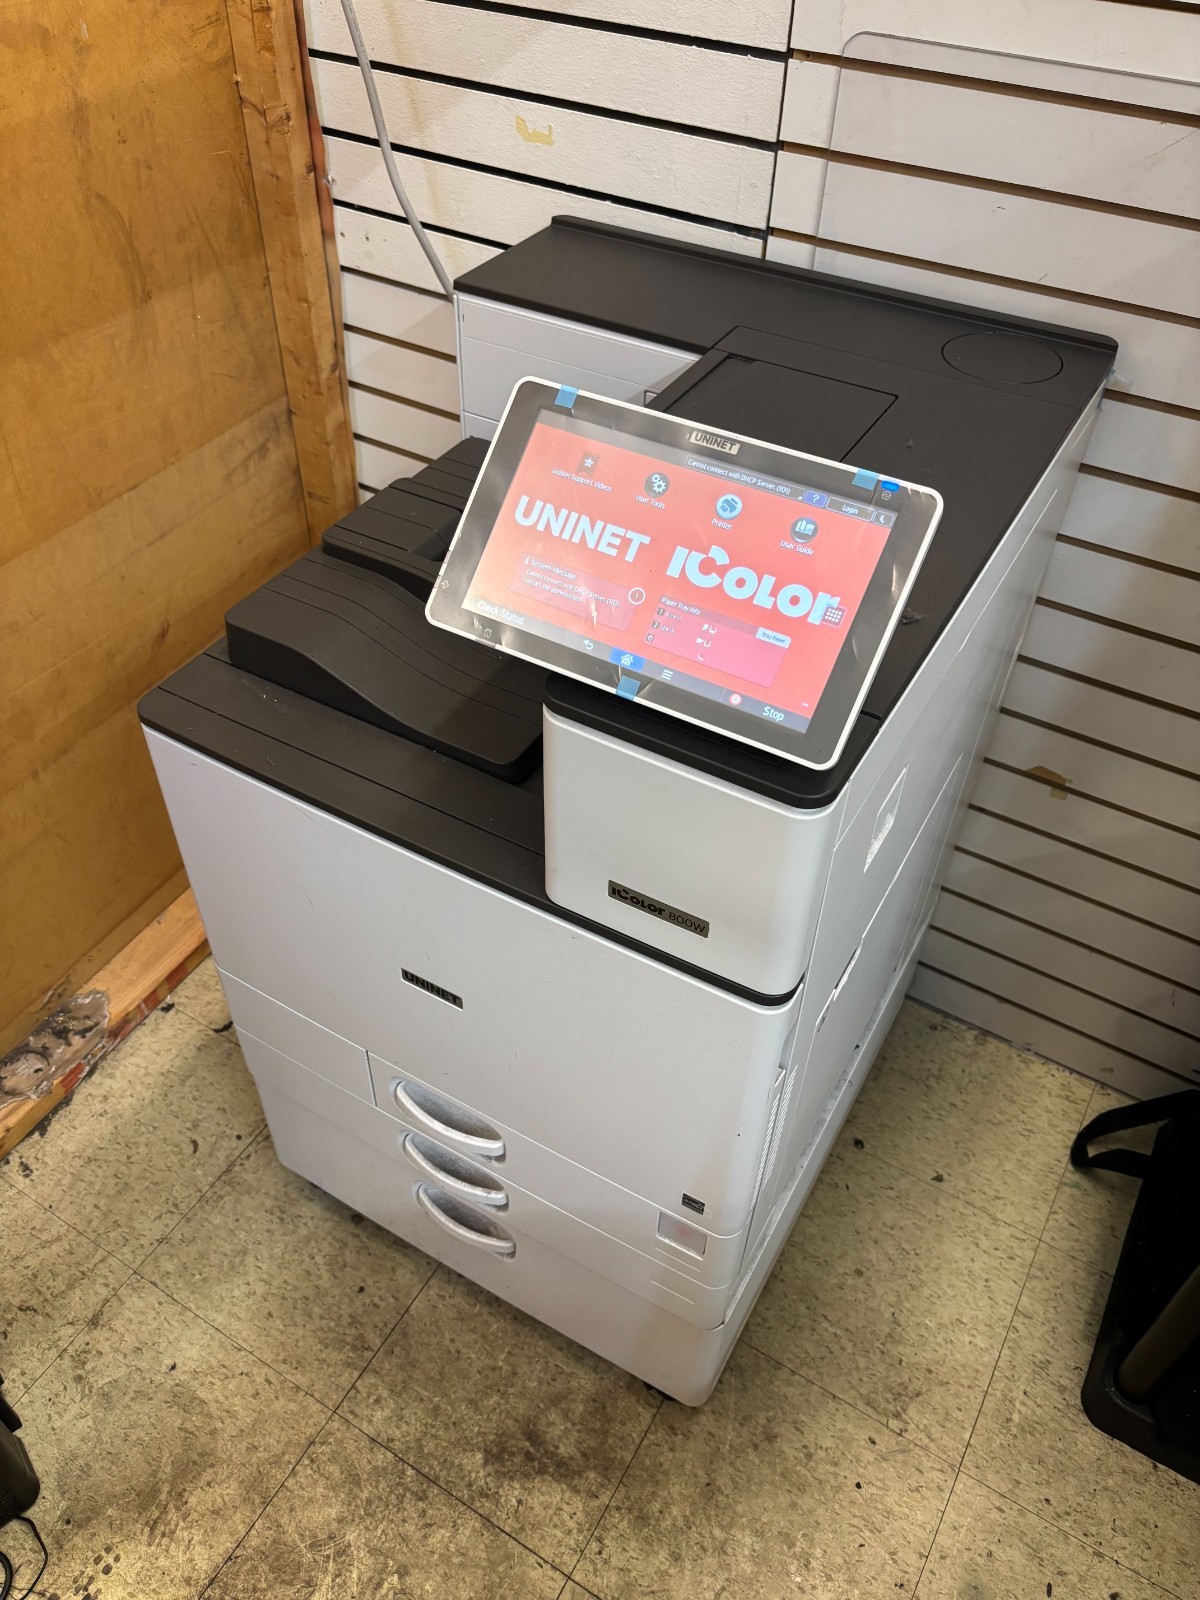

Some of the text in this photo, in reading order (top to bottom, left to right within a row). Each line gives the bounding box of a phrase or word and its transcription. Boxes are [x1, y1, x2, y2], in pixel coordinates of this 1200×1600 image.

[694, 432, 737, 452] UNINET
[571, 473, 593, 487] Support
[594, 480, 612, 493] Videos
[687, 458, 706, 470] Cannot
[706, 465, 728, 477] connect
[728, 472, 741, 480] with
[740, 474, 757, 485] DHCP
[776, 485, 791, 496] (101)
[635, 494, 666, 510] User Tools
[842, 504, 859, 516] Login
[514, 494, 651, 563] UNINET
[711, 518, 733, 531] Printer
[780, 539, 815, 557] User Guide
[666, 545, 840, 625] IColor
[479, 600, 525, 625] Check Status
[678, 602, 690, 613] Tray
[762, 705, 785, 722] Stop
[611, 886, 706, 933] IColor 800W
[404, 970, 460, 1005] UNINET
